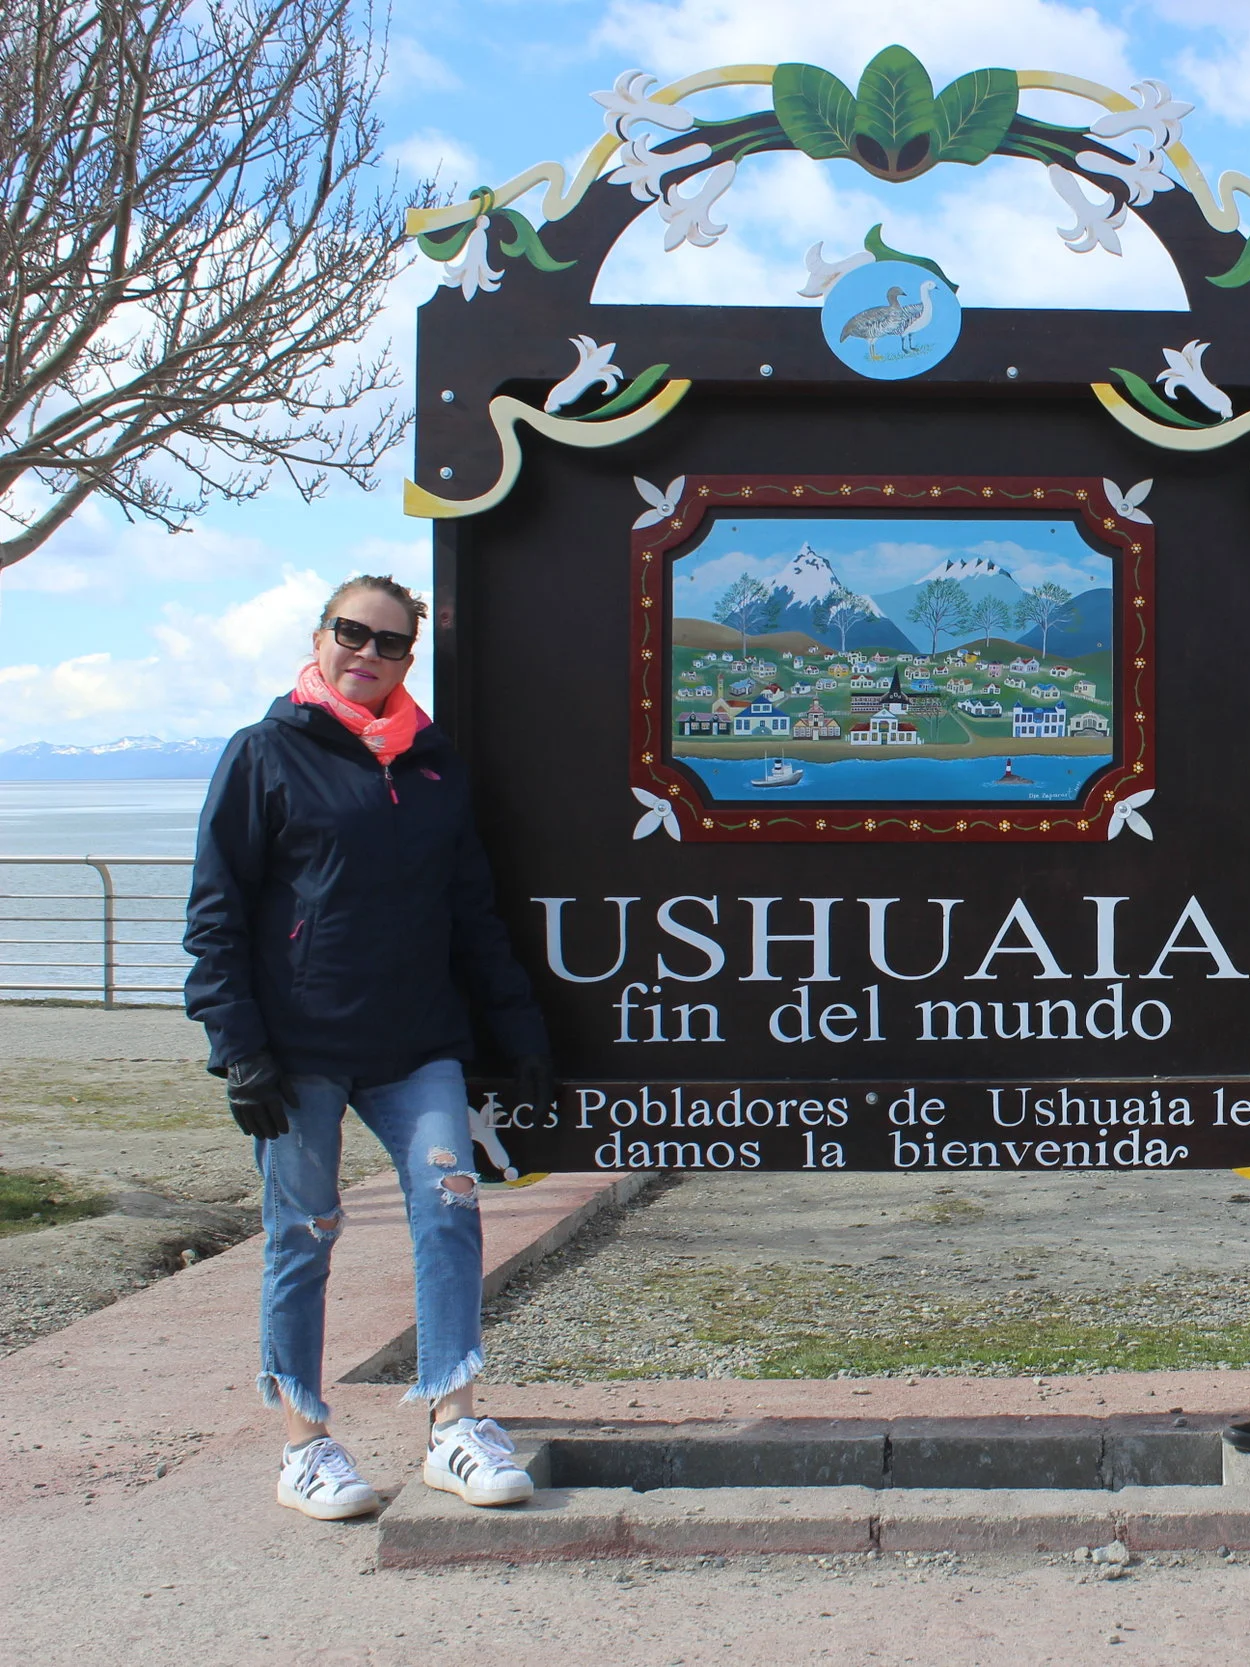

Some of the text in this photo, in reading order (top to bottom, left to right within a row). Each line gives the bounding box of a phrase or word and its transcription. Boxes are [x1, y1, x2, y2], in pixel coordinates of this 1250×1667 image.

[530, 894, 1250, 984] USHUAIA
[612, 982, 1172, 1044] fin del mundo
[575, 1085, 849, 1129] Pobladores
[888, 1087, 946, 1126] de
[986, 1087, 1195, 1127] Ushuaia
[594, 1128, 1189, 1169] damos la bienvenida
